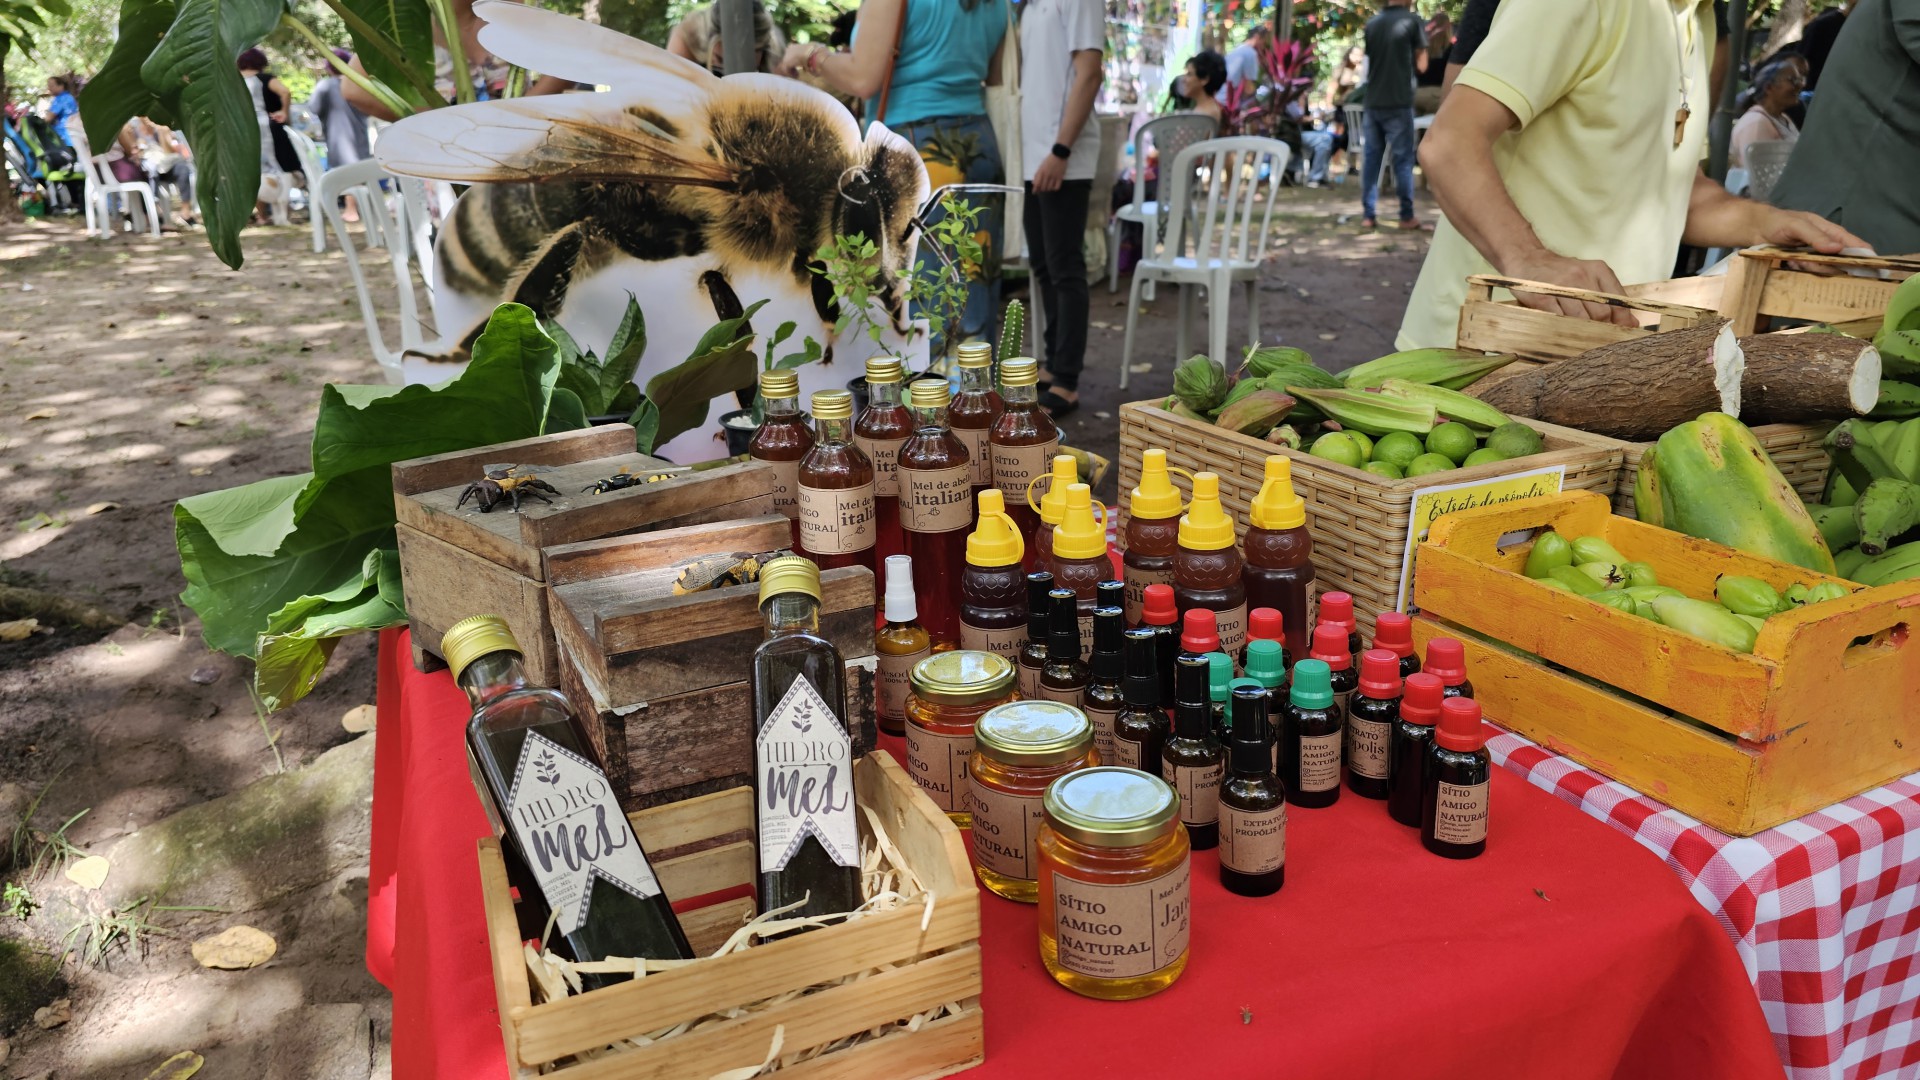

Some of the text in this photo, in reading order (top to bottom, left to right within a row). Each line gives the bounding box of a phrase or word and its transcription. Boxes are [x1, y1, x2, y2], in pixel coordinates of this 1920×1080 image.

[875, 450, 894, 458] Mel
[994, 455, 1020, 466] SÍTIO
[995, 468, 1029, 478] AMIGO
[913, 481, 933, 491] Mel
[936, 481, 950, 490] de
[914, 487, 972, 506] italian
[1479, 490, 1495, 507] de
[839, 497, 871, 511] Mel de
[841, 506, 875, 527] itali
[1215, 620, 1239, 633] ÍTIO
[1219, 631, 1245, 646] MIGO
[989, 640, 1013, 651] Mel
[764, 740, 845, 763] HIDRO
[1302, 750, 1335, 759] AMIGO
[1302, 755, 1341, 766] NATURA
[1441, 786, 1471, 798] SÍTIO
[518, 778, 607, 829] HIDRO
[1440, 799, 1477, 810] AMIGO
[971, 811, 1000, 836] MIGO
[1440, 811, 1488, 823] NATURAL
[1235, 826, 1277, 837] PROPÓLIS
[1058, 893, 1106, 915] SÍTIO
[1060, 914, 1122, 936] AMIGO
[1060, 933, 1151, 956] NATURAL
